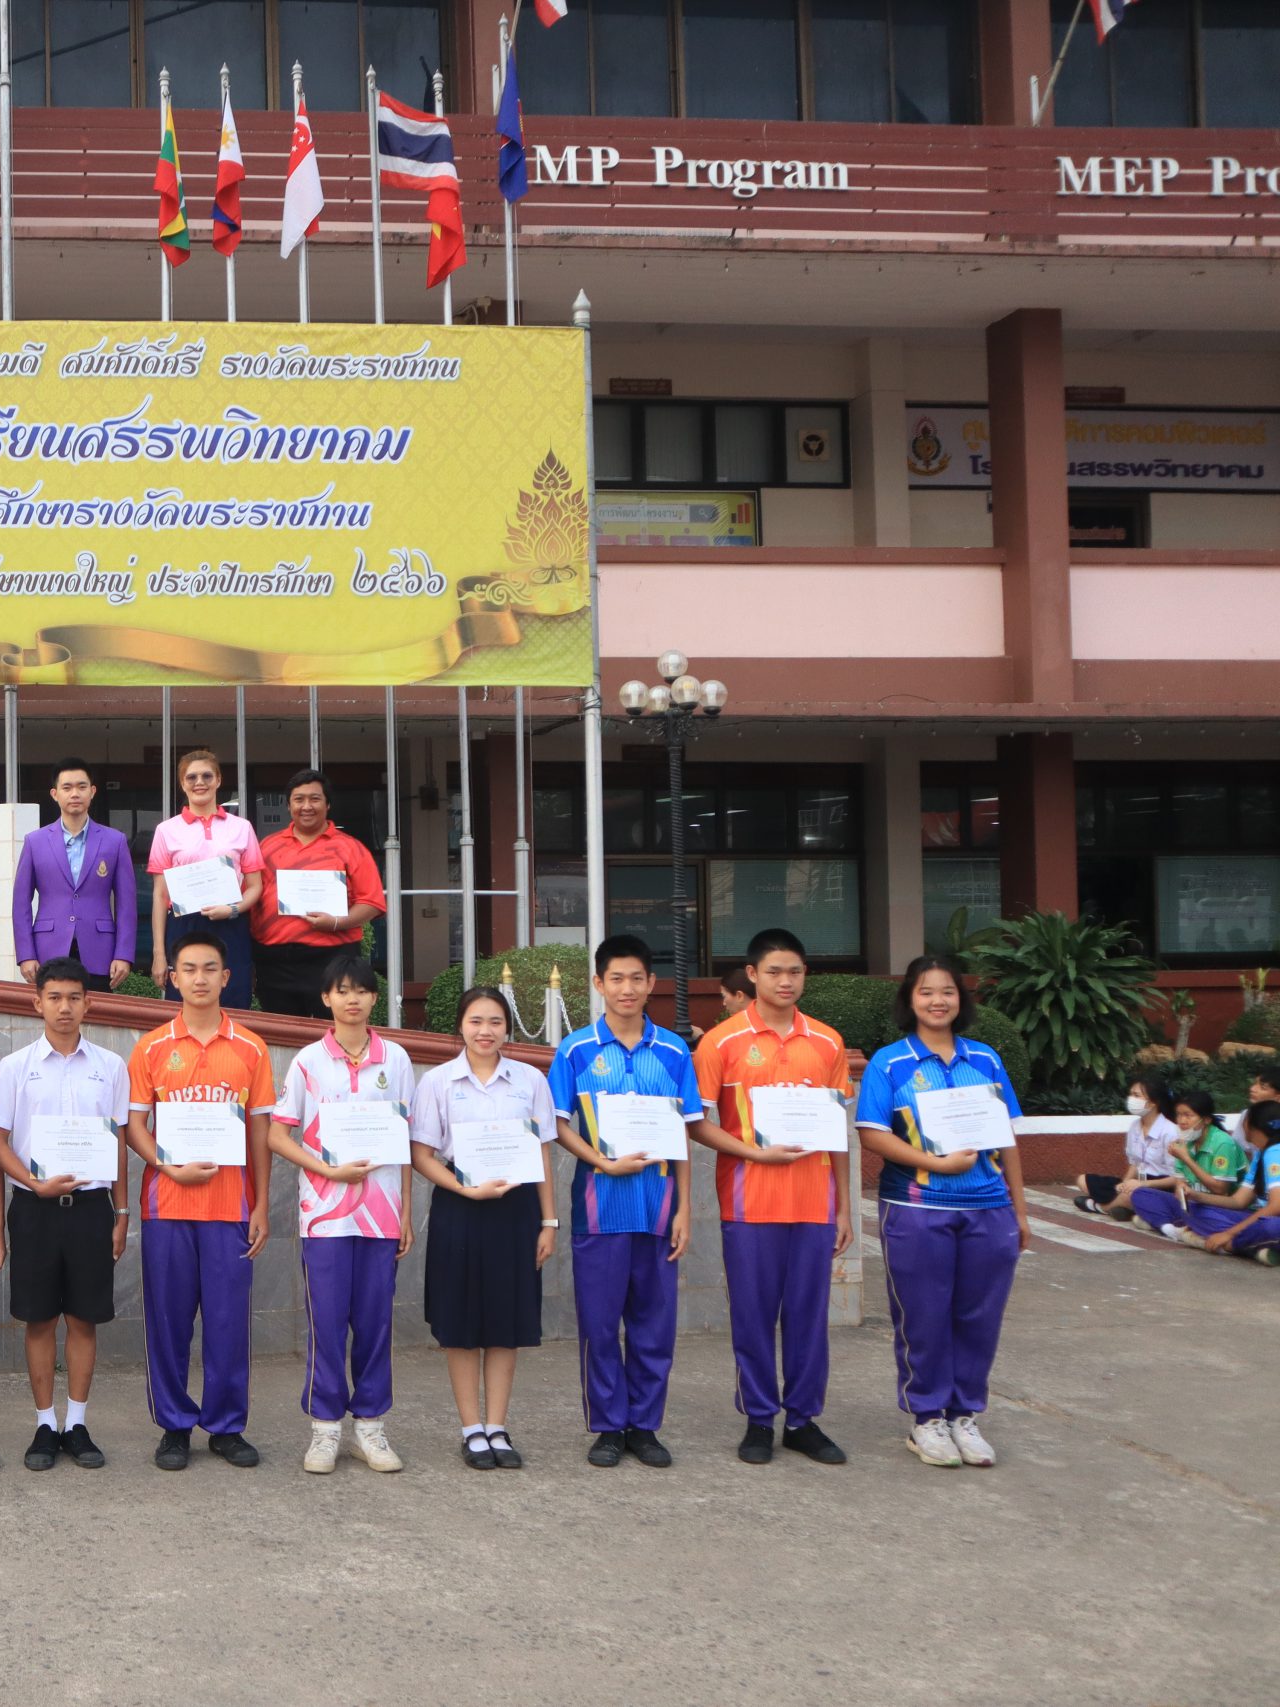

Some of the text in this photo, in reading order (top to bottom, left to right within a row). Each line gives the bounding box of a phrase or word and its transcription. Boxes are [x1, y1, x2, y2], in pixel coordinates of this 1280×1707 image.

[650, 146, 850, 199] Program
[1055, 155, 1180, 197] MEP
[221, 341, 460, 380] รางวัลพระราชทาน
[149, 556, 333, 594] ประจำปีการศึกษา
[352, 547, 447, 597] ๒๕๖๖
